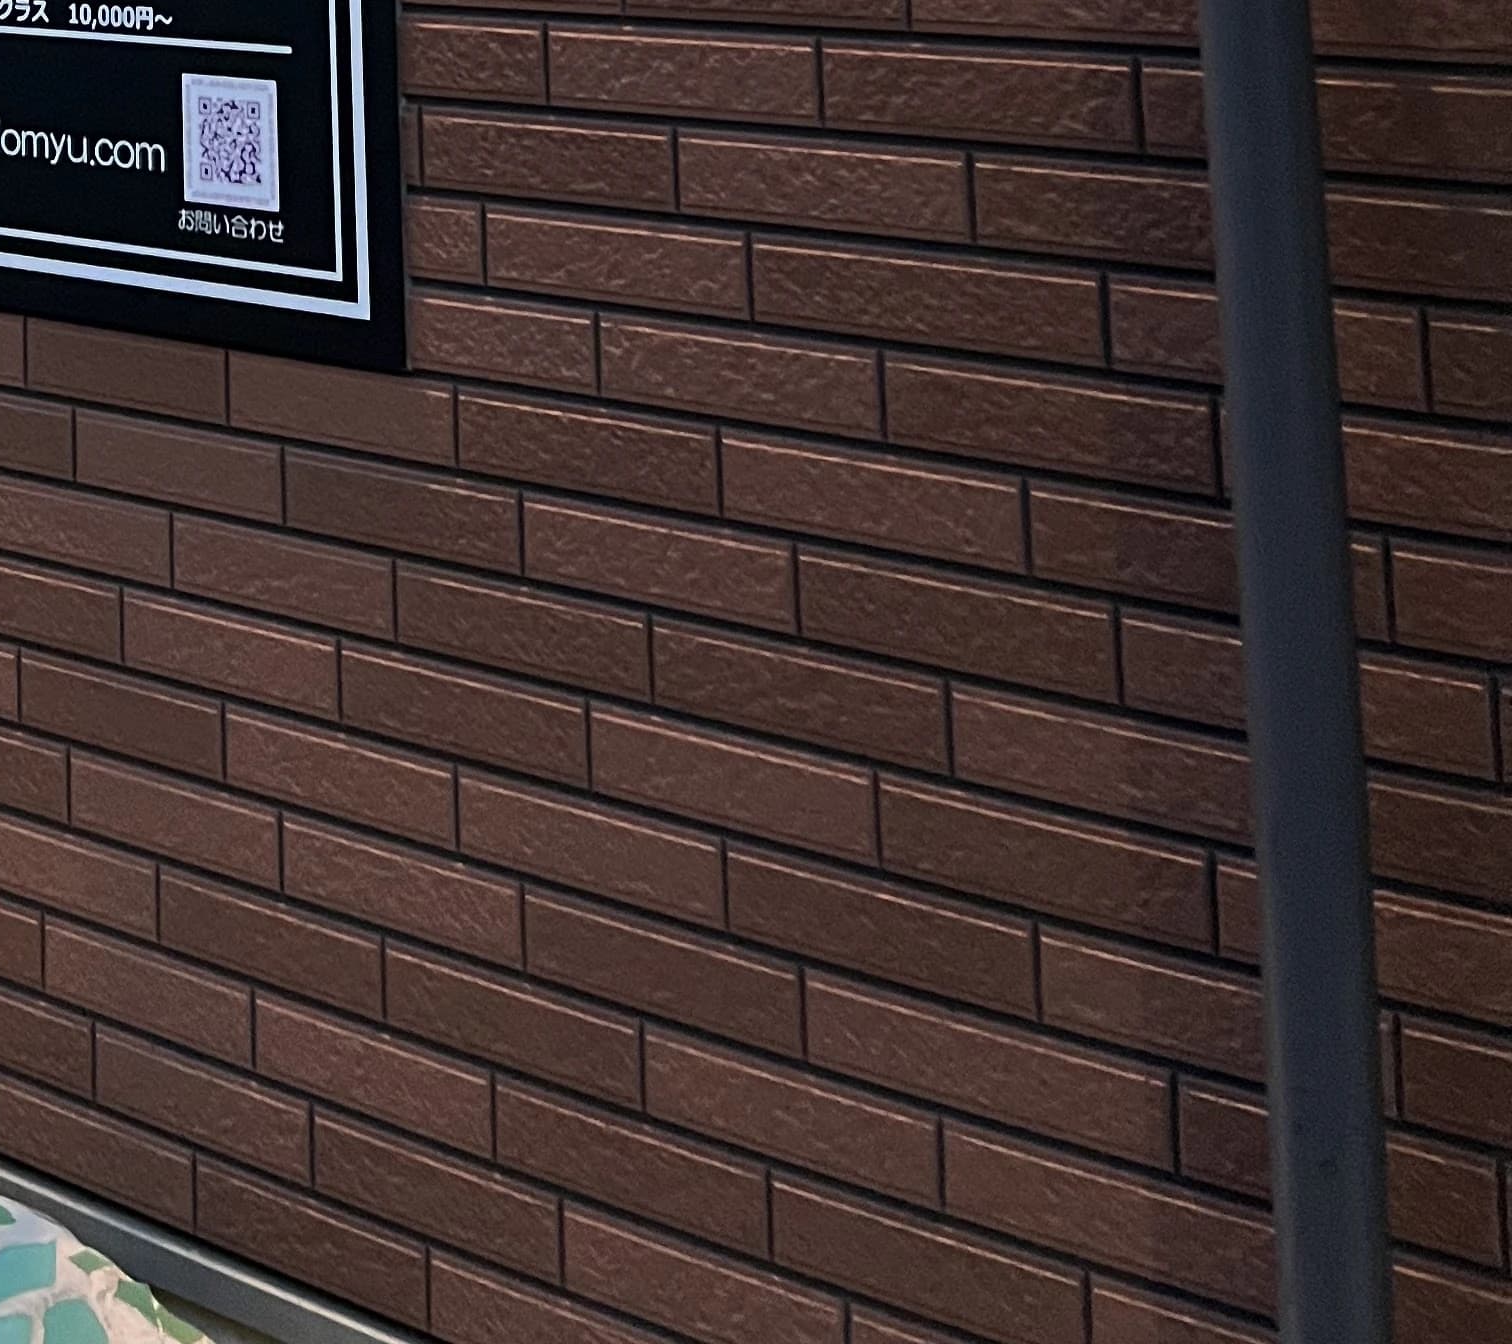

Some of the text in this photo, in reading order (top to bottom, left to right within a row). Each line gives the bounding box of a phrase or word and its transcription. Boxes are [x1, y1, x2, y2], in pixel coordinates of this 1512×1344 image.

[178, 208, 284, 243] お問い合わせ
